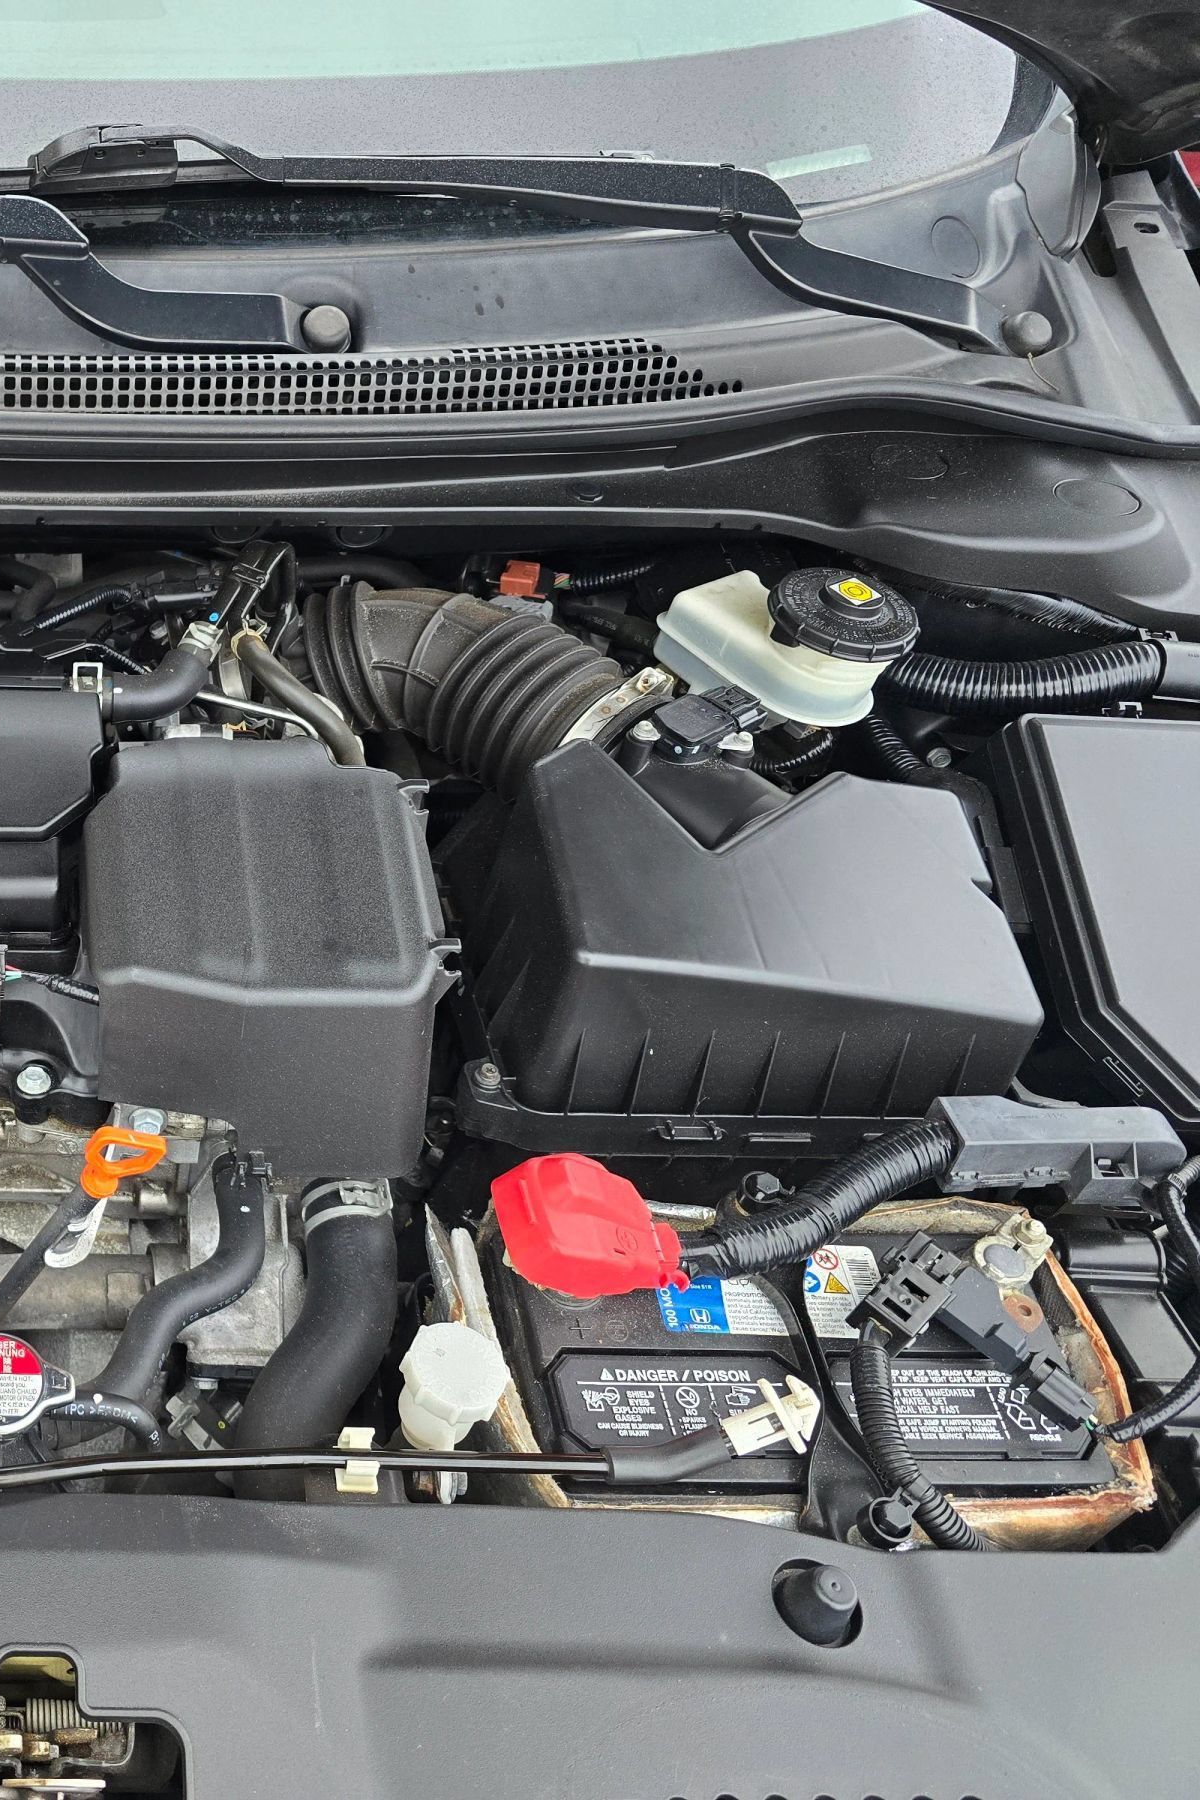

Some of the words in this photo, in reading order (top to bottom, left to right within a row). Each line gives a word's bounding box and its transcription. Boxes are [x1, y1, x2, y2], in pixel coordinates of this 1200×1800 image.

[661, 1288, 674, 1308] MO
[666, 1309, 679, 1328] 100
[614, 1368, 679, 1382] DANGER
[681, 1368, 690, 1382] /
[692, 1368, 752, 1382] POISON
[901, 1369, 915, 1377] OUT
[915, 1369, 926, 1377] OF
[926, 1369, 941, 1377] THE
[963, 1369, 973, 1377] OF
[625, 1390, 655, 1398] SHIELD
[902, 1388, 923, 1397] EYES
[923, 1388, 976, 1397] IMMEDIATELY
[996, 1387, 1007, 1404] LEAD
[628, 1398, 650, 1406] EYES
[931, 1397, 948, 1405] GET
[612, 1406, 657, 1414] EXPLOSIVE
[684, 1408, 698, 1416] NO
[895, 1405, 917, 1413] DICAL
[918, 1405, 939, 1414] HELP
[939, 1405, 960, 1414] FAST
[614, 1414, 643, 1422] GASES
[681, 1416, 707, 1424] SPARKS
[1029, 1433, 1062, 1441] RECYCLE
